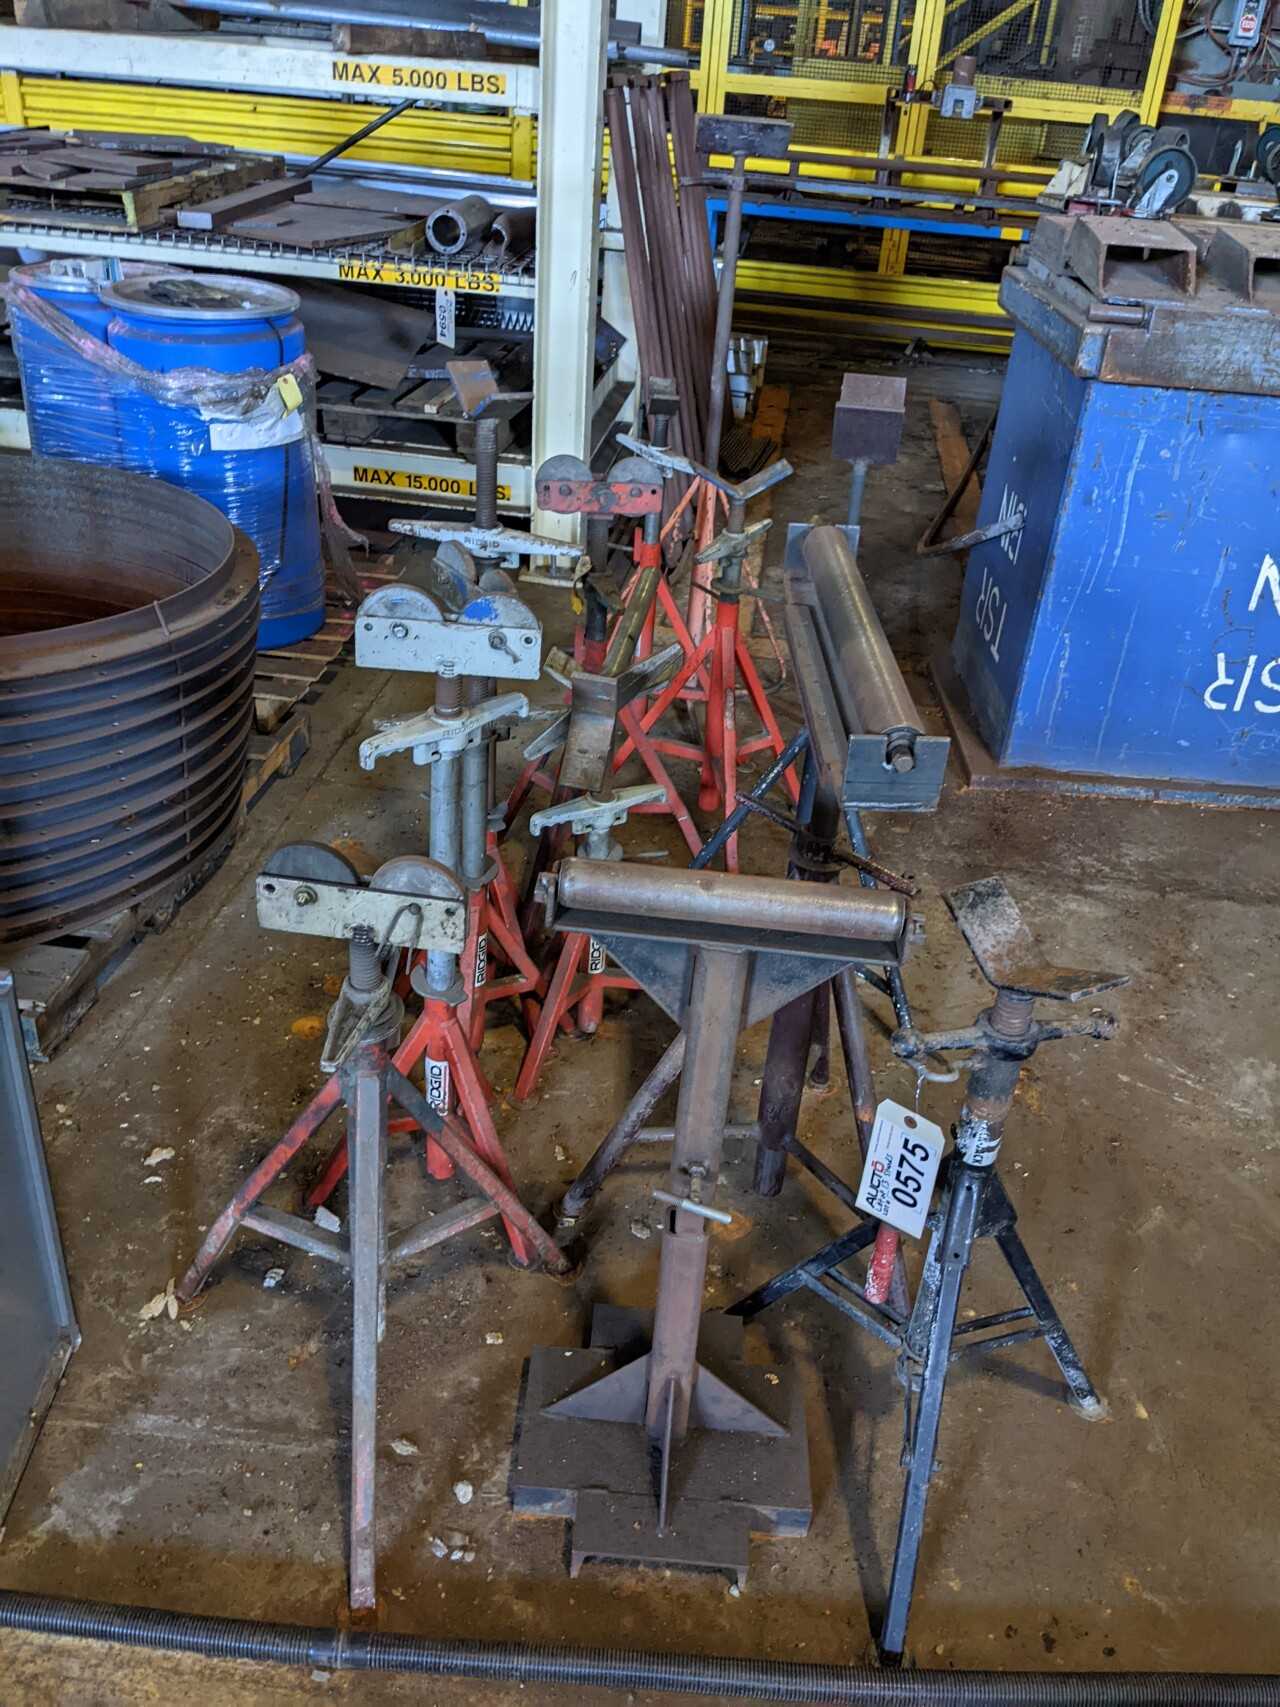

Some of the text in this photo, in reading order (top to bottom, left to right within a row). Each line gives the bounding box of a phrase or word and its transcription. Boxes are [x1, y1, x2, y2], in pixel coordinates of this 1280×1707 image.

[332, 61, 506, 95] MAX 5.000 LBS.
[338, 263, 385, 282] MAX
[353, 467, 512, 501] MAX 15.000 LS.
[477, 938, 487, 984] RIDGID
[890, 1137, 930, 1209] 0575
